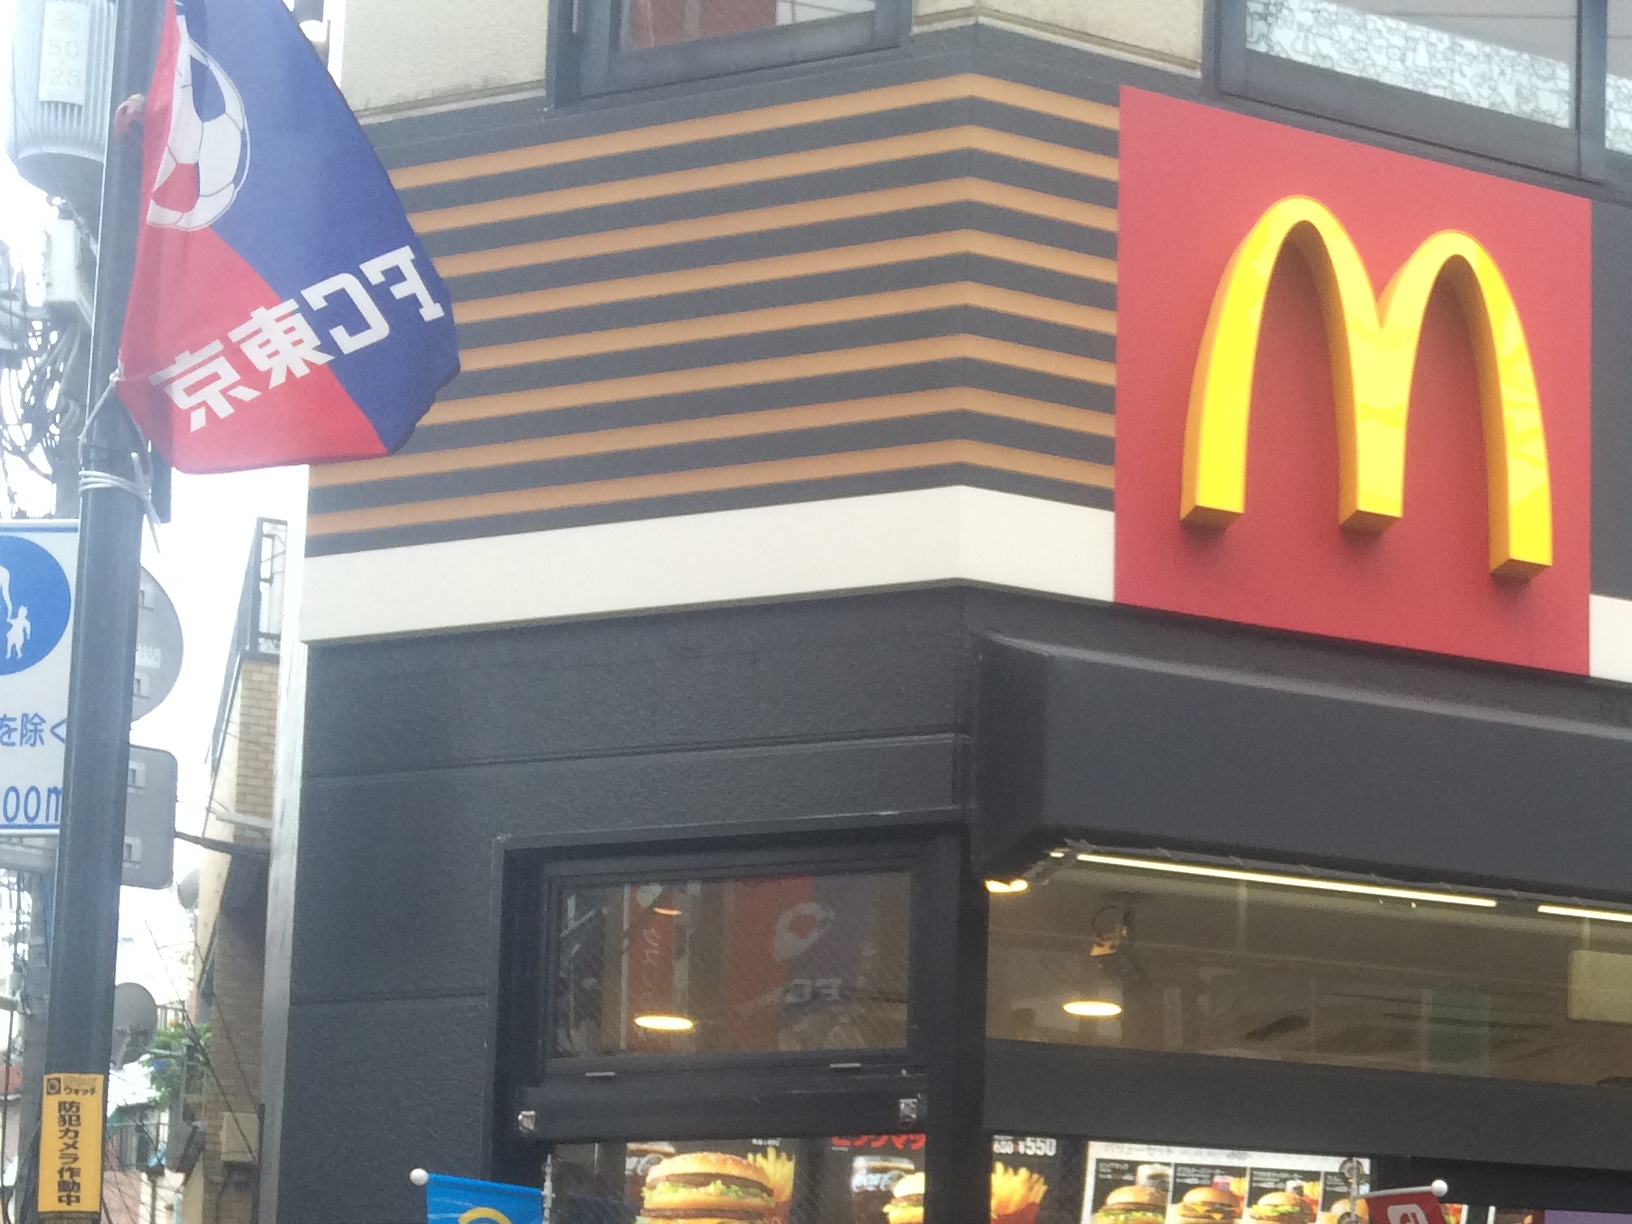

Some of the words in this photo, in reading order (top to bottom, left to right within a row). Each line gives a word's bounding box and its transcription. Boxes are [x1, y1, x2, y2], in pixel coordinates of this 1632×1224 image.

[57, 1100, 82, 1207] 防犯カメラ作動中
